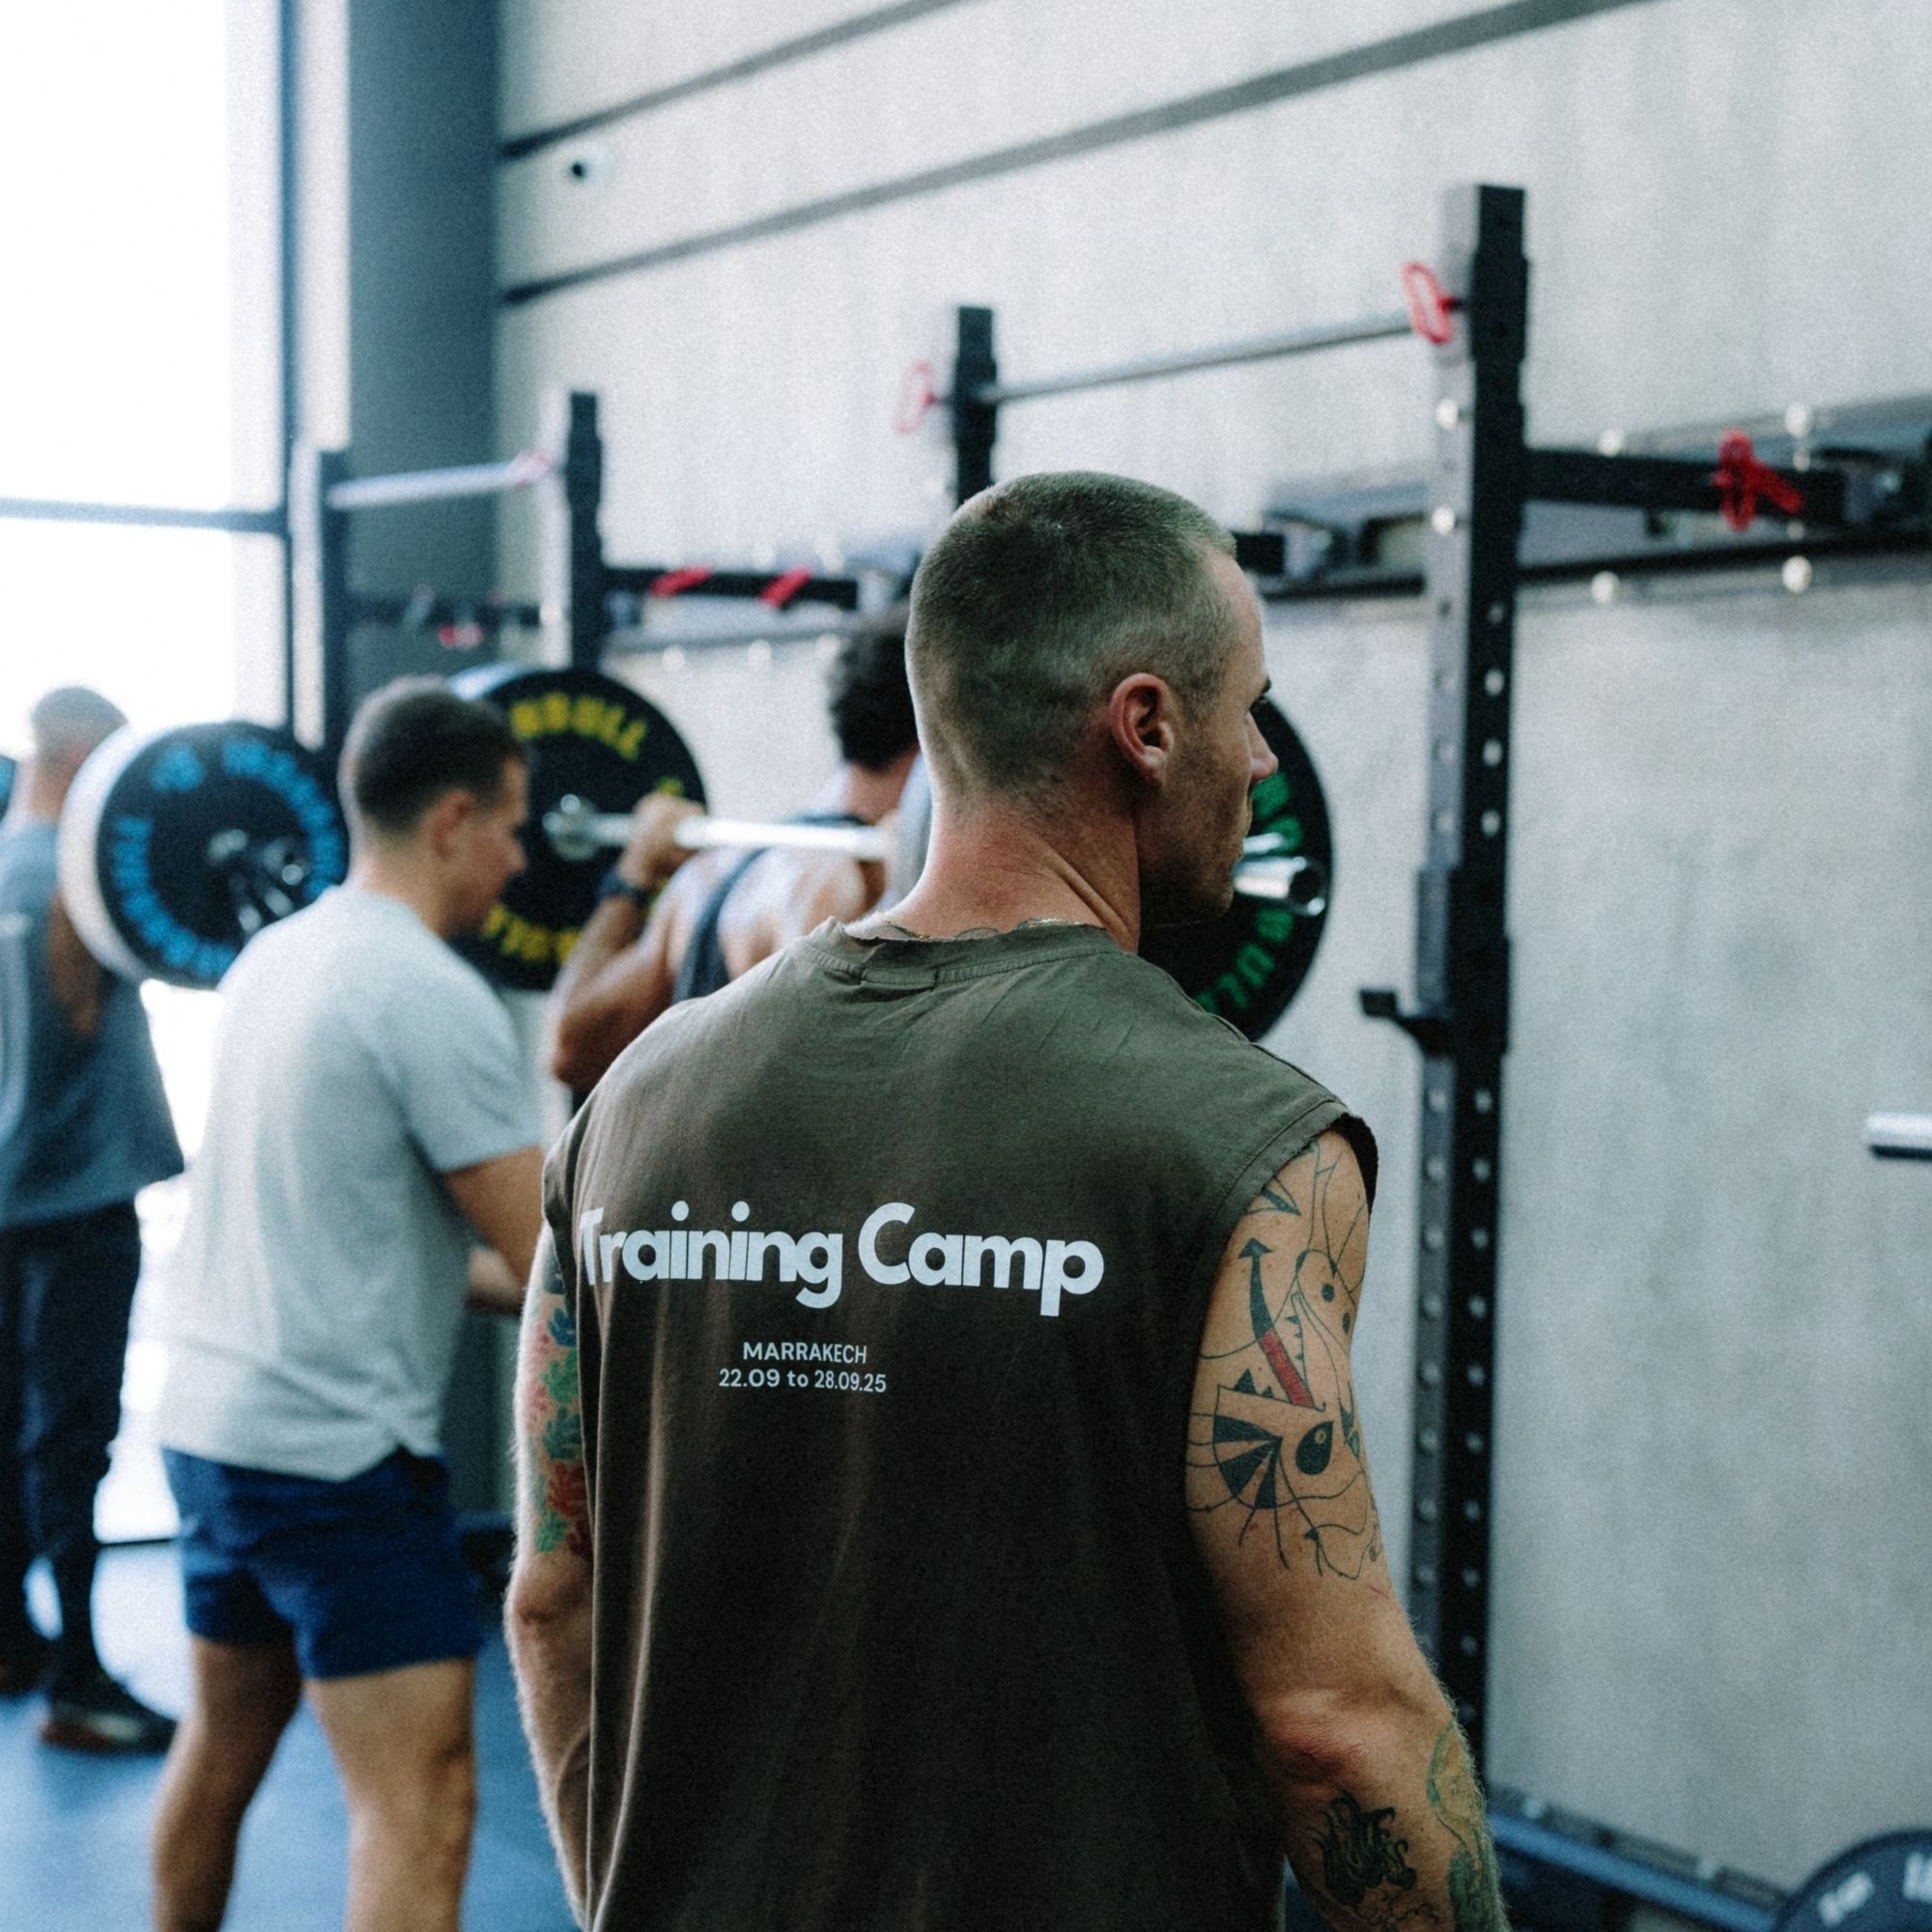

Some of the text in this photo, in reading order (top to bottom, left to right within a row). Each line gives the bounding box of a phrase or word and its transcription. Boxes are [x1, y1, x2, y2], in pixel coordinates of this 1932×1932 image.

[579, 1200, 1105, 1317] Training Camp
[742, 1341, 867, 1364] MARRAKECH
[718, 1368, 887, 1394] 22.09 to 28.09.25
